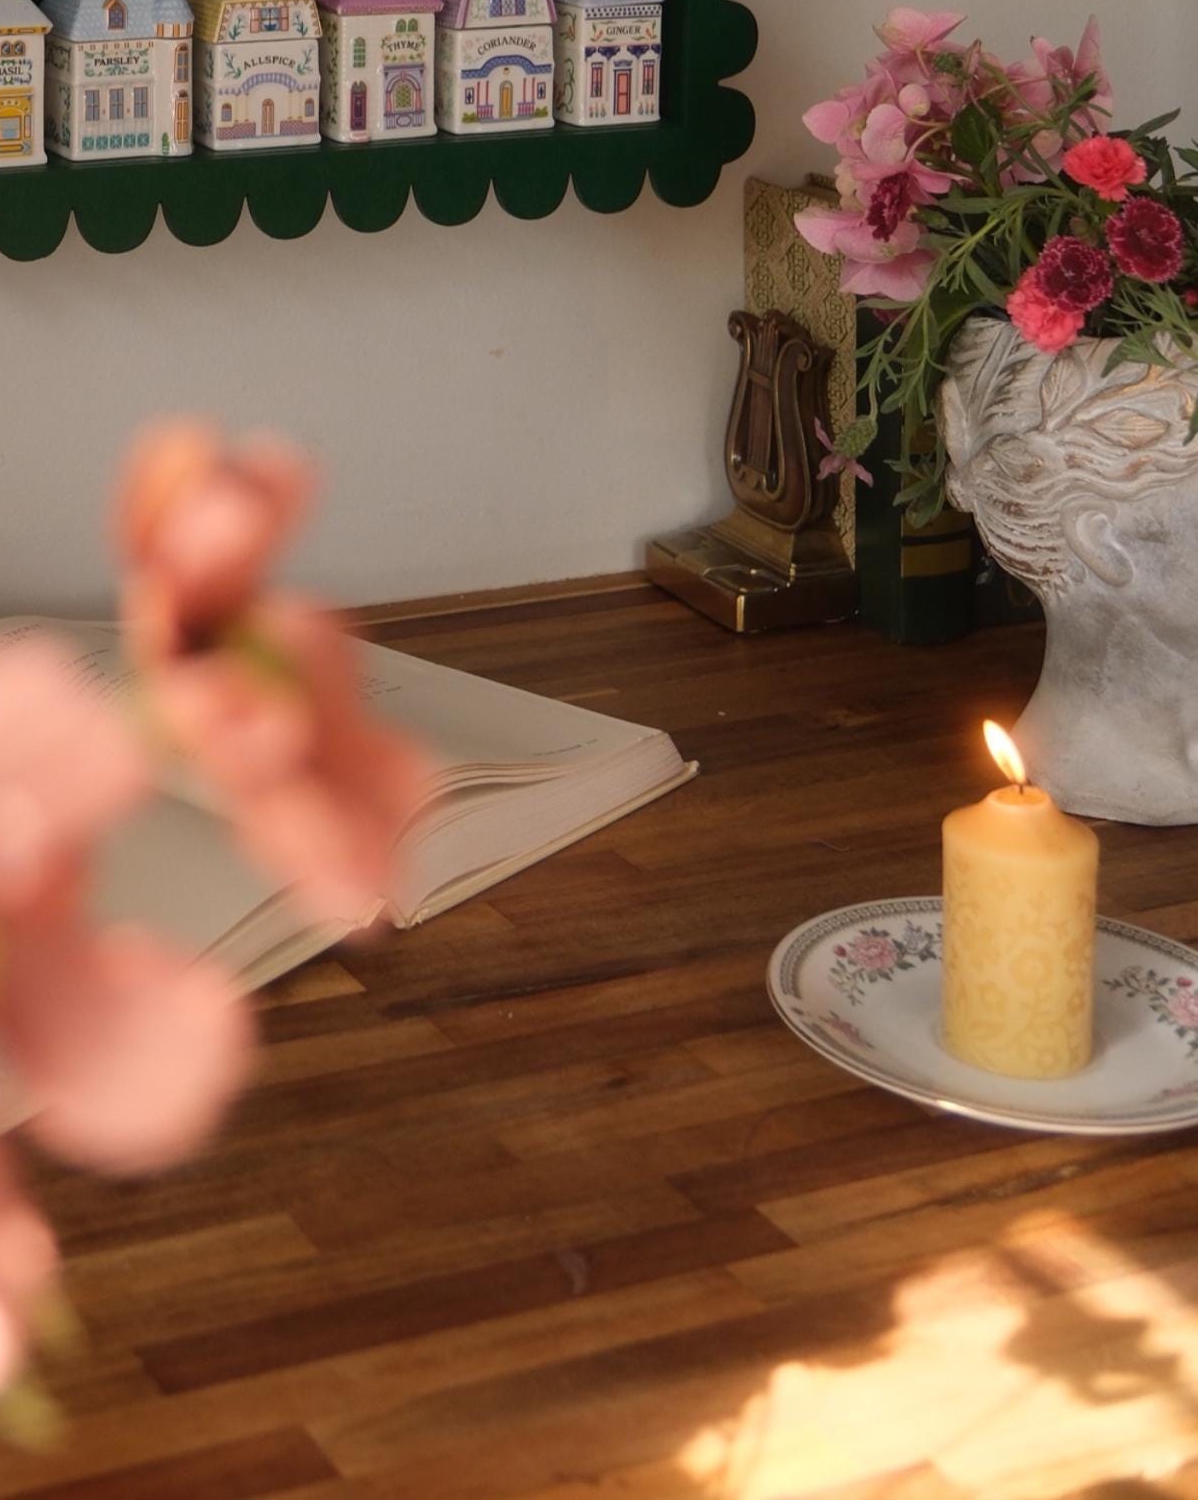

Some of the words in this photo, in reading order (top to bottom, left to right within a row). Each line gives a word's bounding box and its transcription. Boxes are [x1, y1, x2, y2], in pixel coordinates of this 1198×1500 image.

[606, 26, 641, 35] GINGER
[386, 41, 421, 52] THYME
[478, 36, 536, 55] CORIANDER
[94, 56, 140, 65] PARSLEY
[243, 55, 296, 70] ALLSPICE
